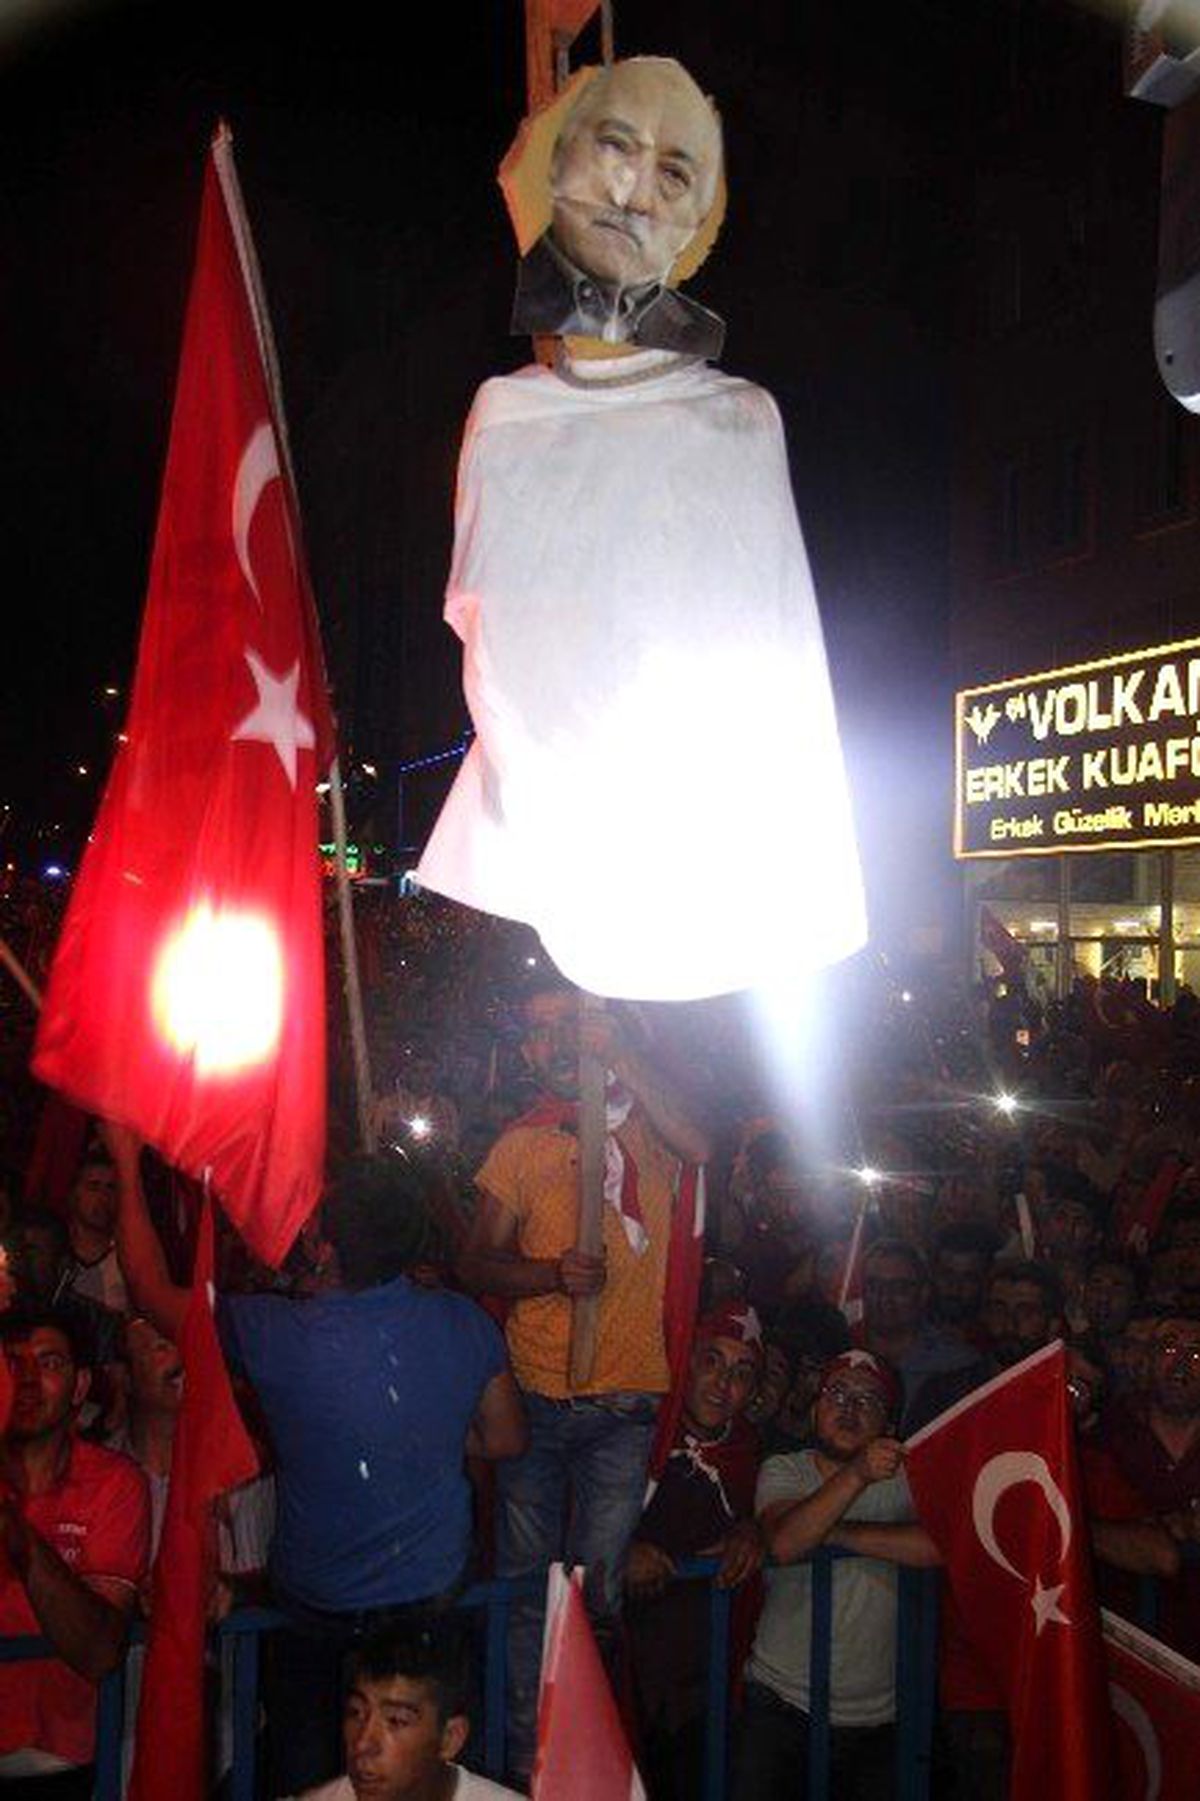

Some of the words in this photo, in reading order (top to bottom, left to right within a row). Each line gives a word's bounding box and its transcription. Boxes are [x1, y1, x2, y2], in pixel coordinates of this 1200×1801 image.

[966, 756, 1070, 803] ERKEK
[990, 815, 1043, 841] Erkek
[1143, 800, 1200, 827] Mer
